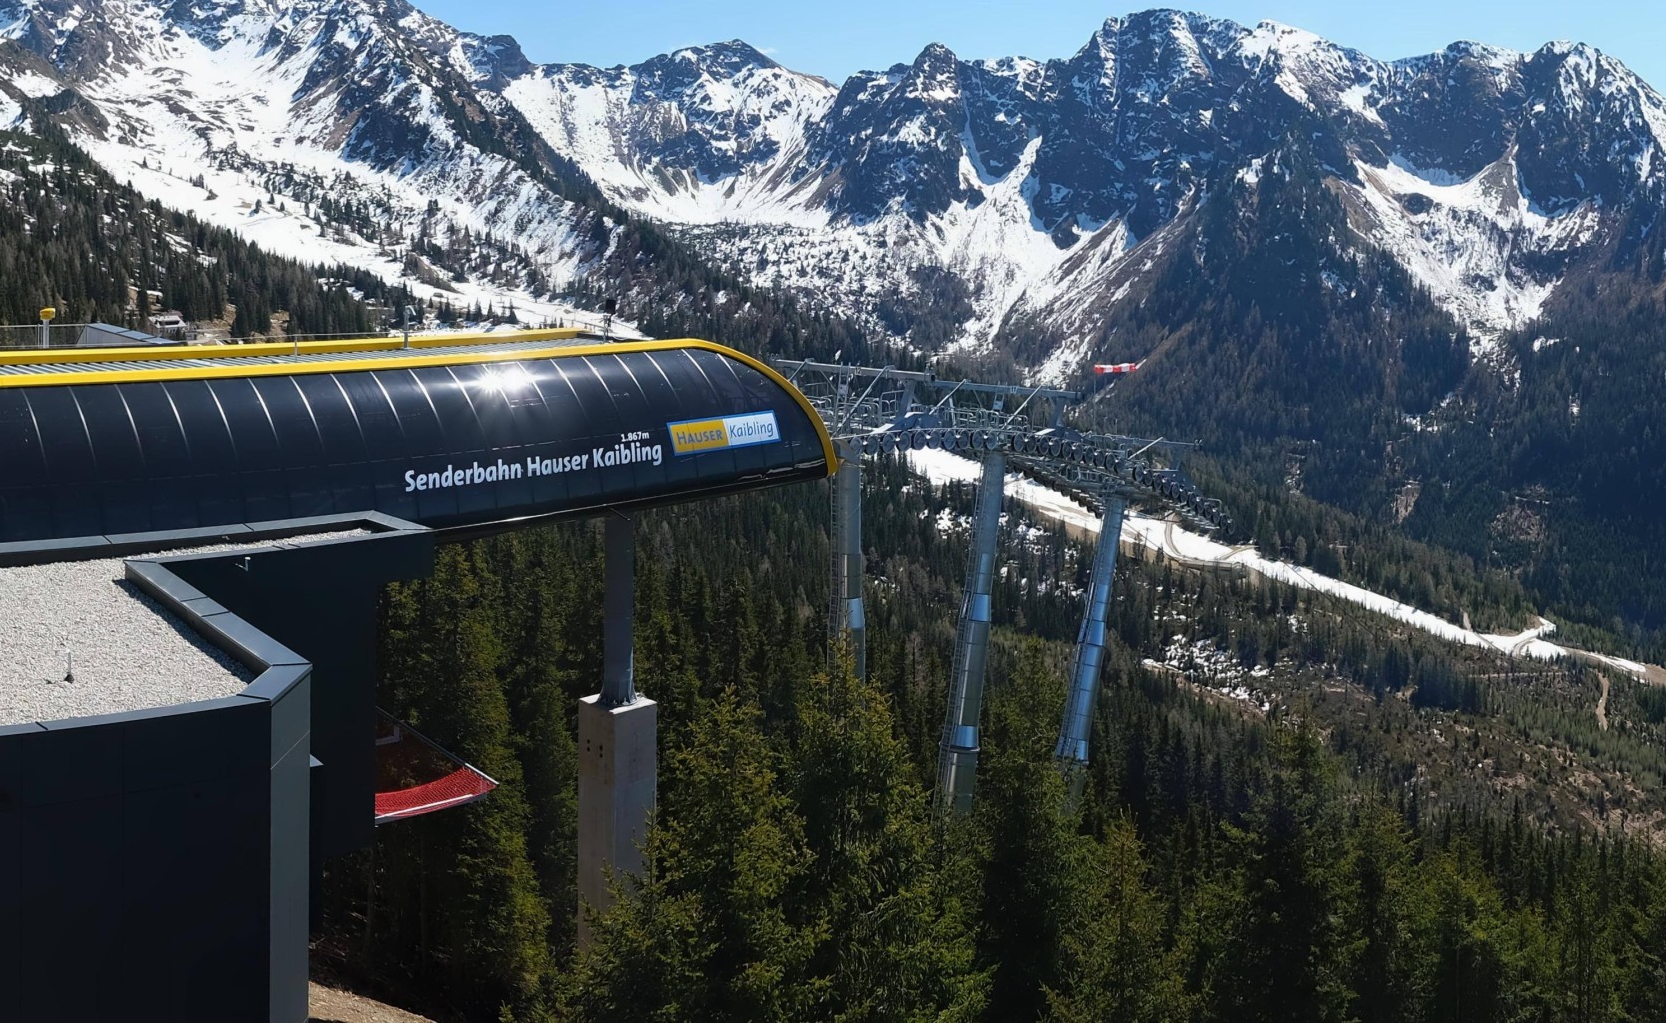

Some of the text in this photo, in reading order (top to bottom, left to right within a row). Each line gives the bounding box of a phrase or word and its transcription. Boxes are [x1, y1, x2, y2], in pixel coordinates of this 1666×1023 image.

[620, 431, 650, 442] 1.867m
[676, 421, 774, 445] HAUSER Kaibling
[405, 442, 663, 492] Senderbahn Hauser Kaibling
